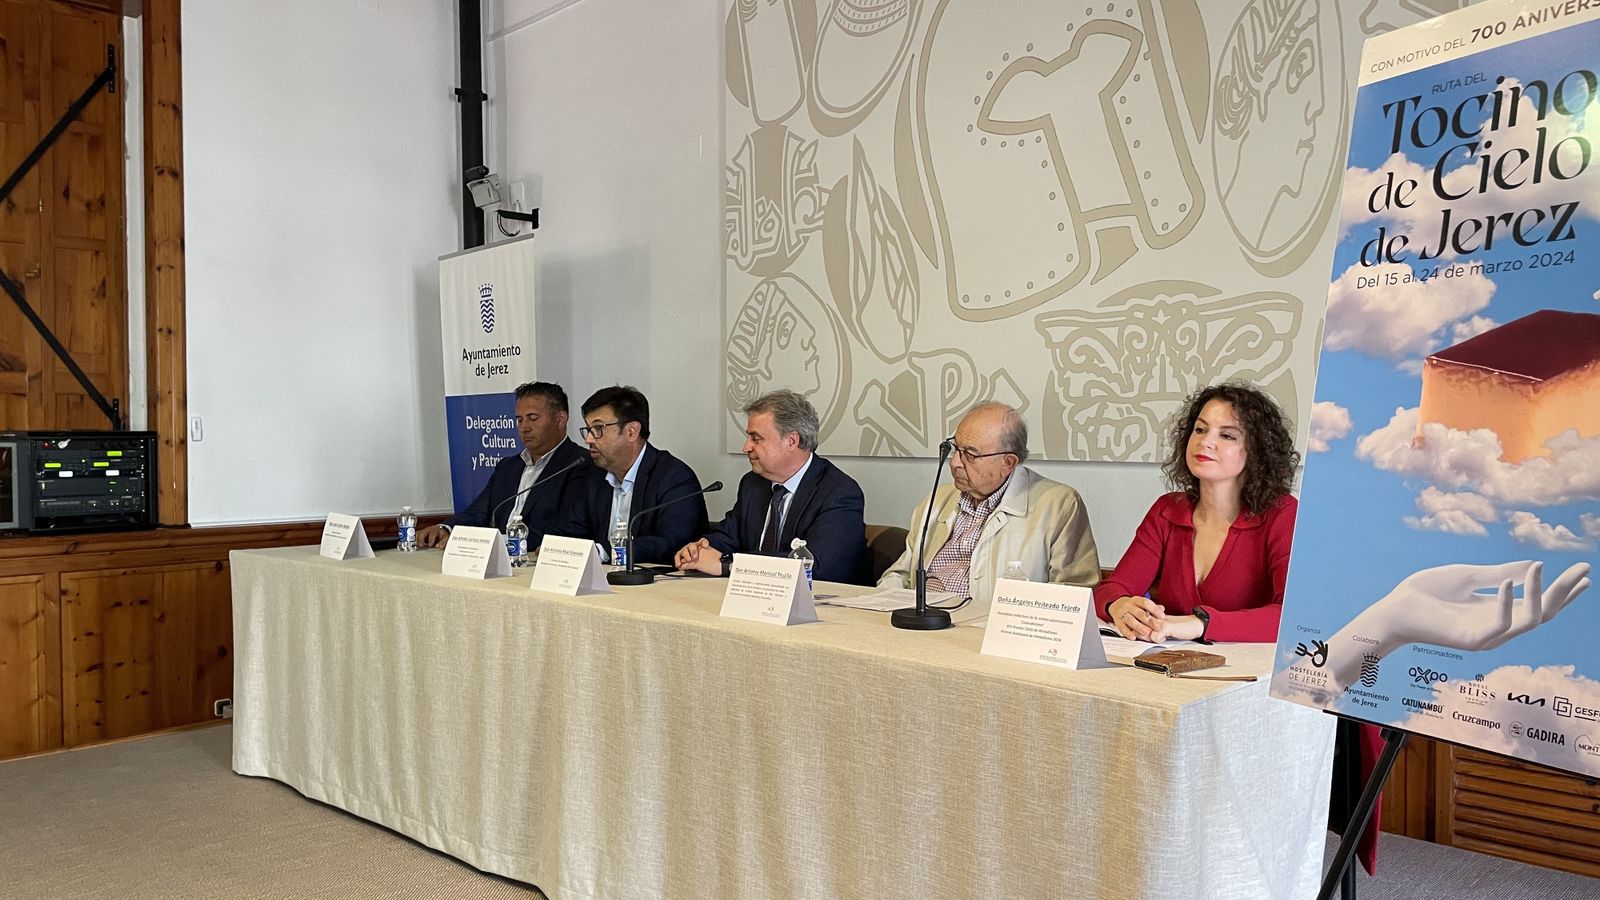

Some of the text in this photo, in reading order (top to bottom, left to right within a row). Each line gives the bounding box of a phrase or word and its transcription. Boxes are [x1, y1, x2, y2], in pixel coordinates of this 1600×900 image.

[1371, 60, 1394, 73] CON
[1396, 45, 1441, 65] MOTIVO
[1443, 37, 1466, 52] DEL
[1471, 21, 1506, 43] 700
[1432, 72, 1487, 95] RUTA DEL
[1383, 69, 1598, 154] Tocino
[1368, 126, 1592, 214] de Cielo
[1360, 201, 1581, 268] de Jerez
[1356, 249, 1576, 290] Del 15 al 24 de marzo 2024
[462, 344, 521, 364] Ayuntamiento
[475, 362, 509, 378] de Jerez
[466, 414, 514, 433] Delegación
[481, 433, 517, 449] Cultura
[471, 456, 477, 470] y
[1297, 625, 1321, 634] Organiza
[1352, 635, 1380, 645] Colabora
[1412, 645, 1463, 661] Patrocinadores
[1288, 672, 1299, 682] DE
[1301, 675, 1328, 688] JEREZ
[1344, 686, 1390, 702] Ayuntamiento
[1459, 685, 1496, 701] BLISS
[1351, 696, 1378, 709] de Jerez
[1575, 706, 1600, 718] GESF
[1452, 711, 1500, 730] Cruzcampo
[1527, 727, 1565, 746] GADIRA
